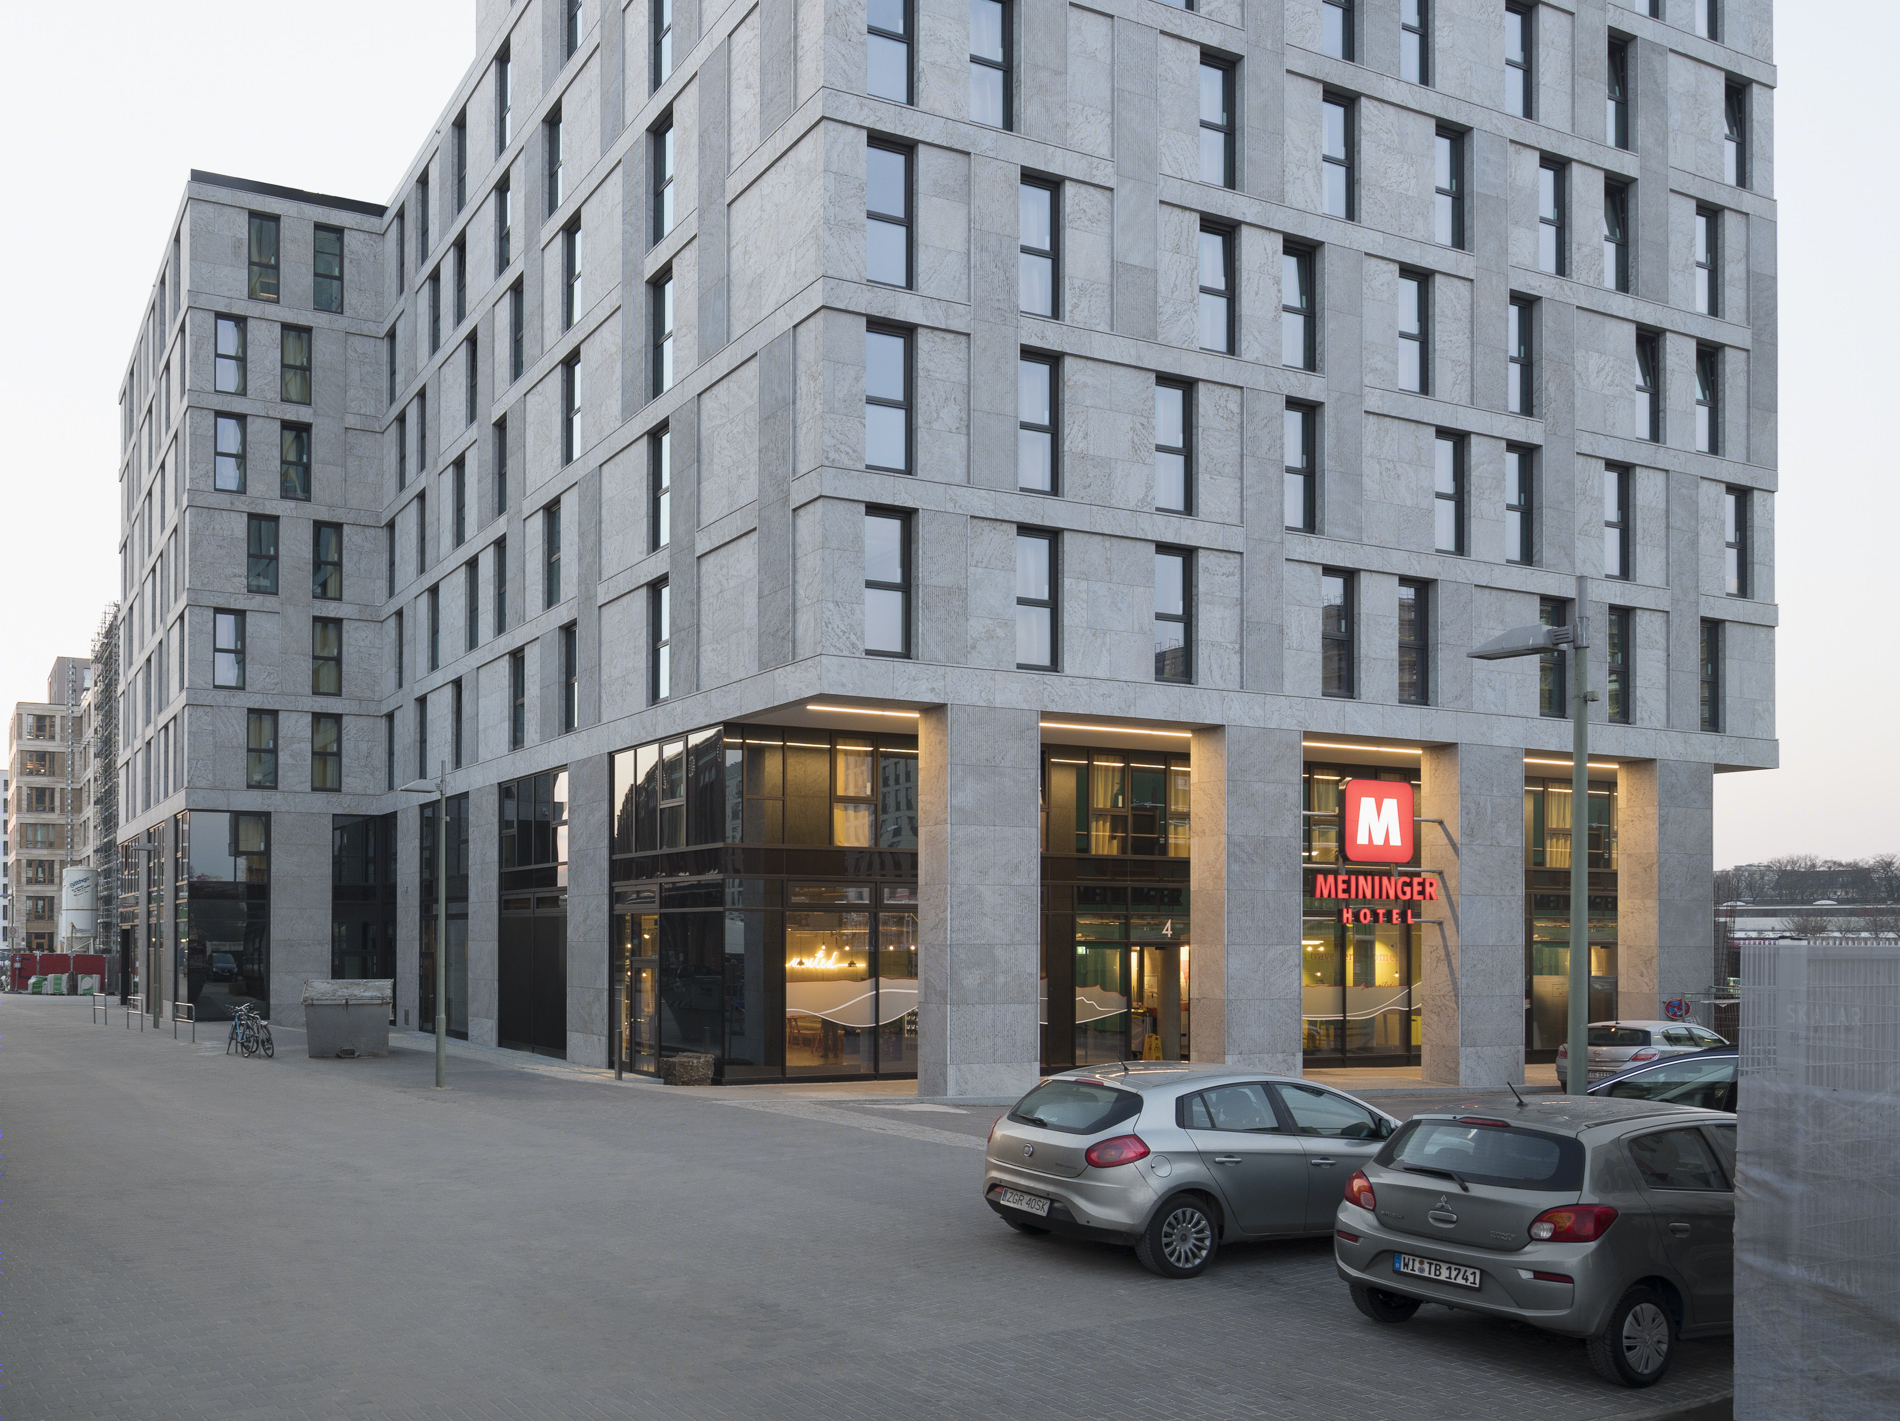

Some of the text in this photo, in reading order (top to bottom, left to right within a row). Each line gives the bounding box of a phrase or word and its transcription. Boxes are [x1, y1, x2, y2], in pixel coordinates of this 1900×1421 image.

[1356, 796, 1402, 847] M
[1314, 874, 1439, 901] MEININGER
[1161, 918, 1173, 938] 4
[1342, 908, 1415, 925] HOTEL
[1006, 1191, 1025, 1207] ZGR
[1402, 1256, 1478, 1286] WI TB 1741
